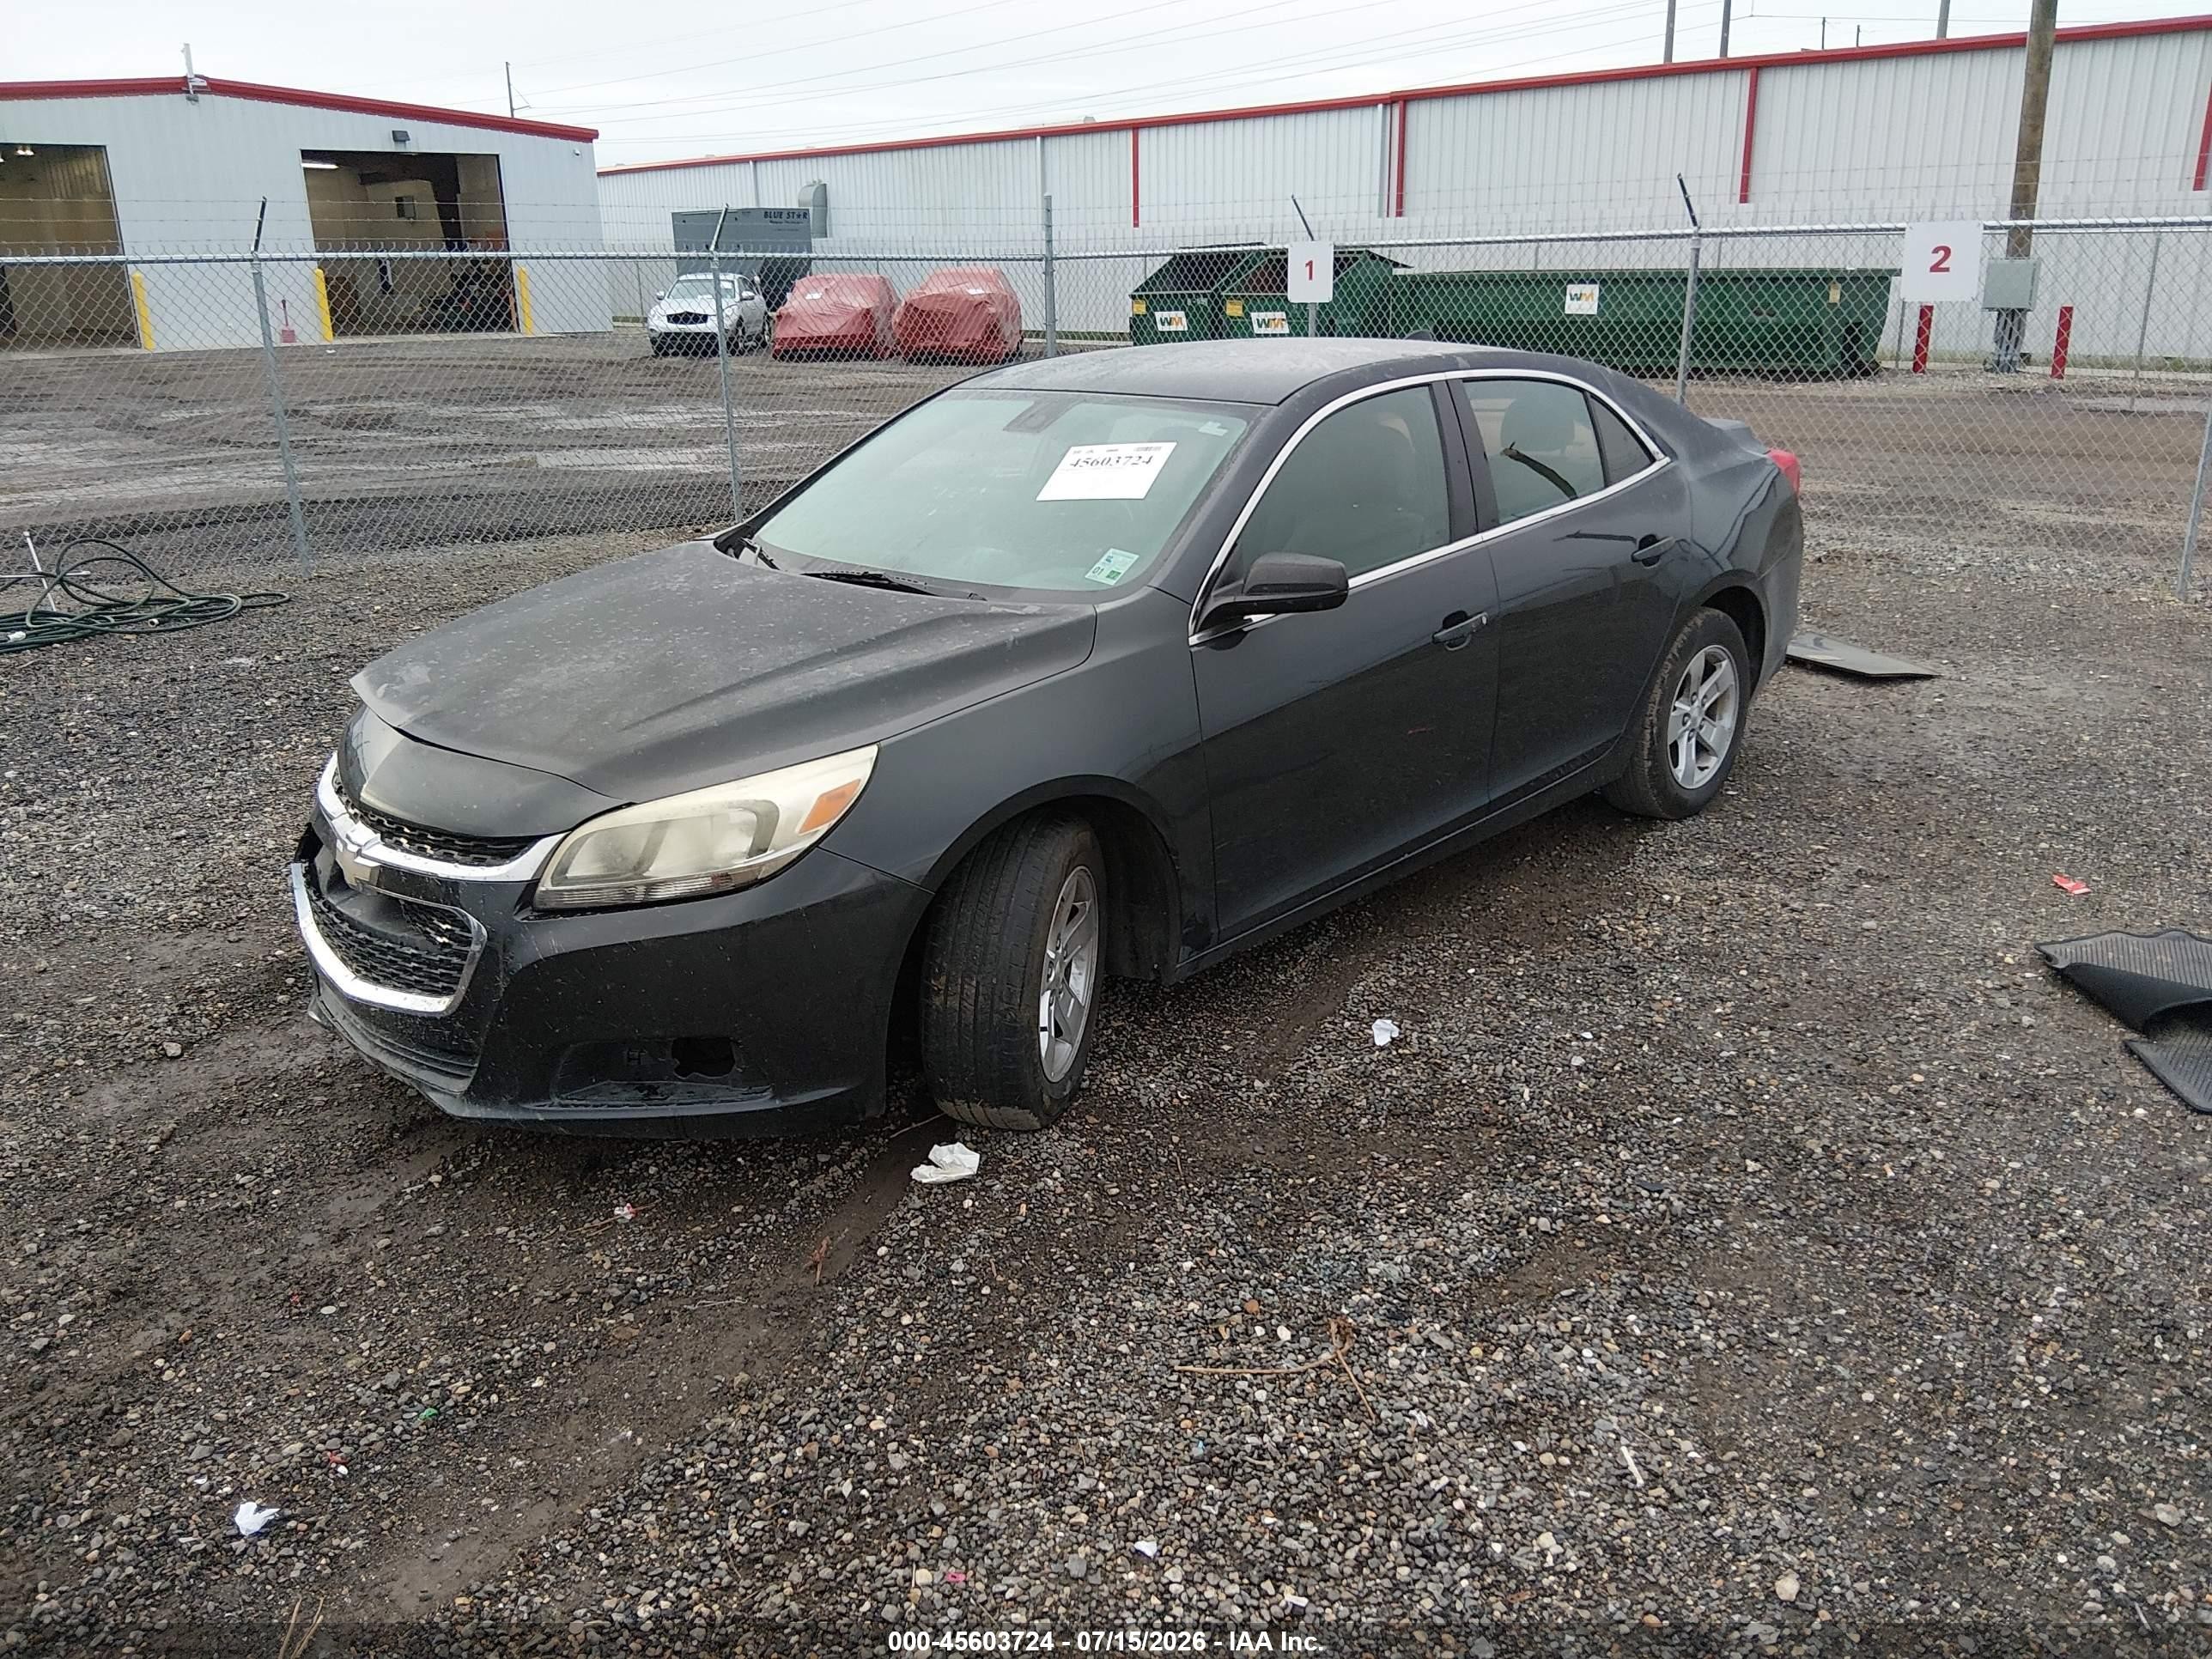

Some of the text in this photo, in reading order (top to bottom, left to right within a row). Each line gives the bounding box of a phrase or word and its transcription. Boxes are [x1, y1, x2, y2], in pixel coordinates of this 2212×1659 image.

[1929, 246, 1952, 273] 2
[1304, 260, 1314, 281] 1
[1570, 293, 1595, 302] WM
[1160, 316, 1183, 327] WM
[1255, 318, 1285, 328] WM
[1070, 455, 1153, 467] 45603724
